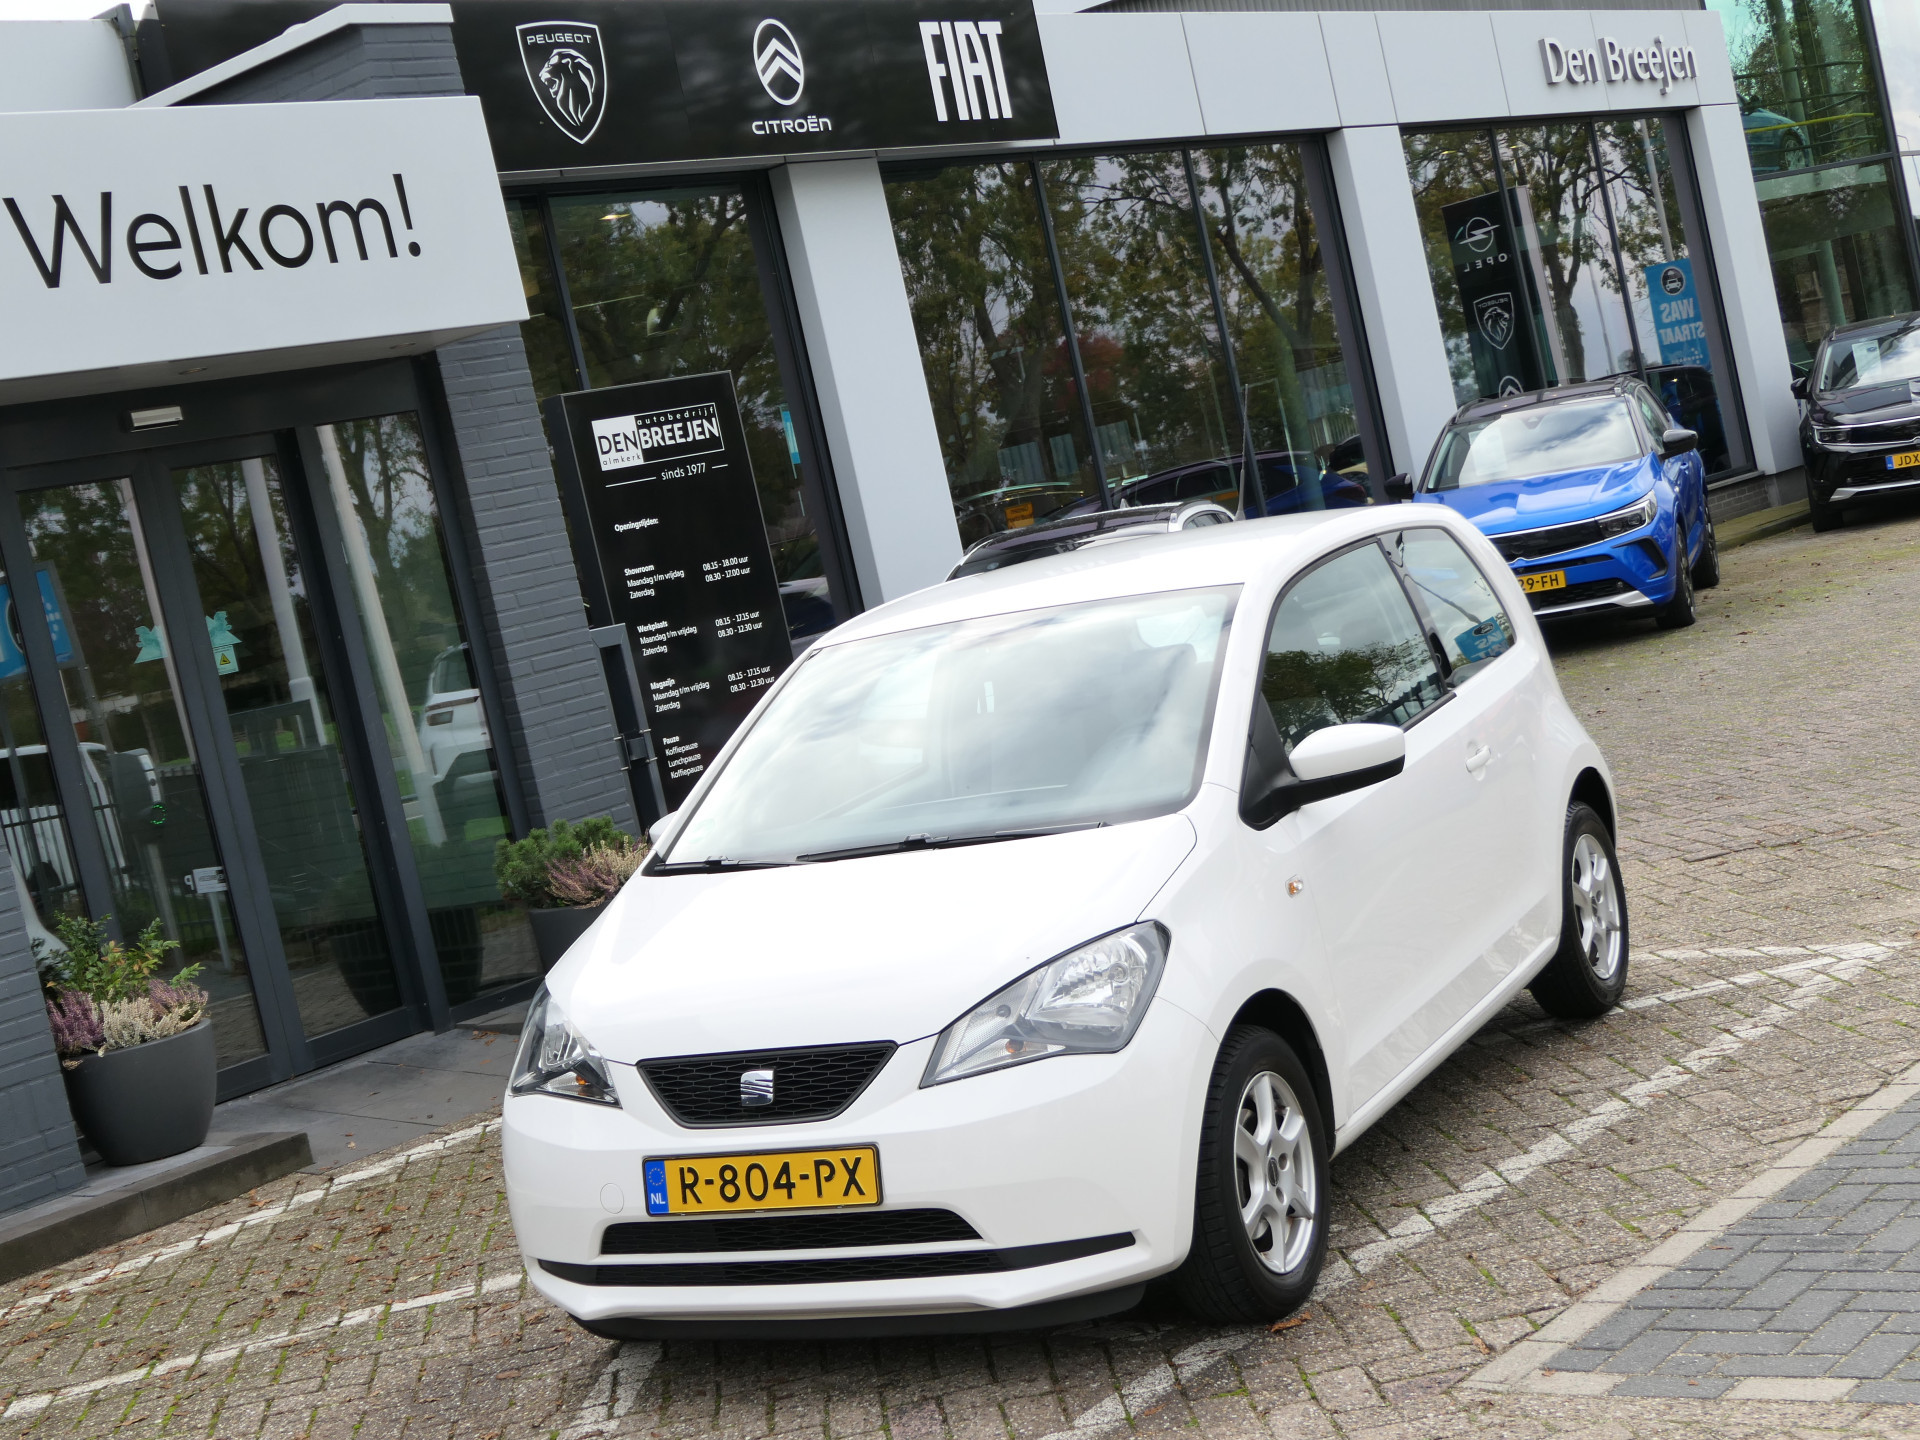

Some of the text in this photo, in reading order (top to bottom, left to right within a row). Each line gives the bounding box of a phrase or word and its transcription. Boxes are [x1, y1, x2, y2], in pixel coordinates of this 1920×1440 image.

[526, 33, 592, 45] PEUGEOT
[918, 20, 1013, 122] FIAT
[1538, 34, 1699, 95] Den Breejen
[752, 115, 832, 134] CITROËN
[1, 173, 422, 288] Welkom!
[637, 406, 714, 426] autobedrijf
[597, 417, 719, 455] DEN BREEJEN
[602, 454, 641, 466] almkerk
[661, 462, 706, 480] sinds 1977
[624, 564, 655, 576] Showroom
[702, 561, 718, 571] 08.15
[738, 556, 748, 564] uur
[626, 576, 654, 587] Maandag
[664, 570, 685, 580] vrijdag
[705, 572, 721, 582] 08.30
[740, 567, 750, 575] uur
[629, 588, 655, 599] Zaterdag
[715, 616, 731, 627] 08.15
[750, 611, 760, 619] uur
[637, 621, 668, 633] Werkplaats
[717, 628, 734, 638] 08.30
[752, 622, 763, 630] uur
[639, 633, 667, 645] Maandag
[677, 626, 698, 637] vrijdag
[642, 645, 668, 657] Zaterdag
[727, 671, 743, 682] 08.15
[760, 666, 771, 674] uur
[650, 677, 675, 690] Magazijn
[652, 689, 680, 701] Maandag
[690, 681, 710, 692] vrijdag
[730, 682, 746, 693] 08.30
[764, 676, 775, 684] uur
[654, 701, 681, 713] Zaterdag
[662, 735, 680, 745] Pauze
[665, 742, 699, 756] Koffiepauze
[667, 753, 701, 768] Lunchpauze
[670, 764, 704, 779] Koffiepauze
[679, 1156, 866, 1205] R-804-PX
[651, 1193, 666, 1205] NL
